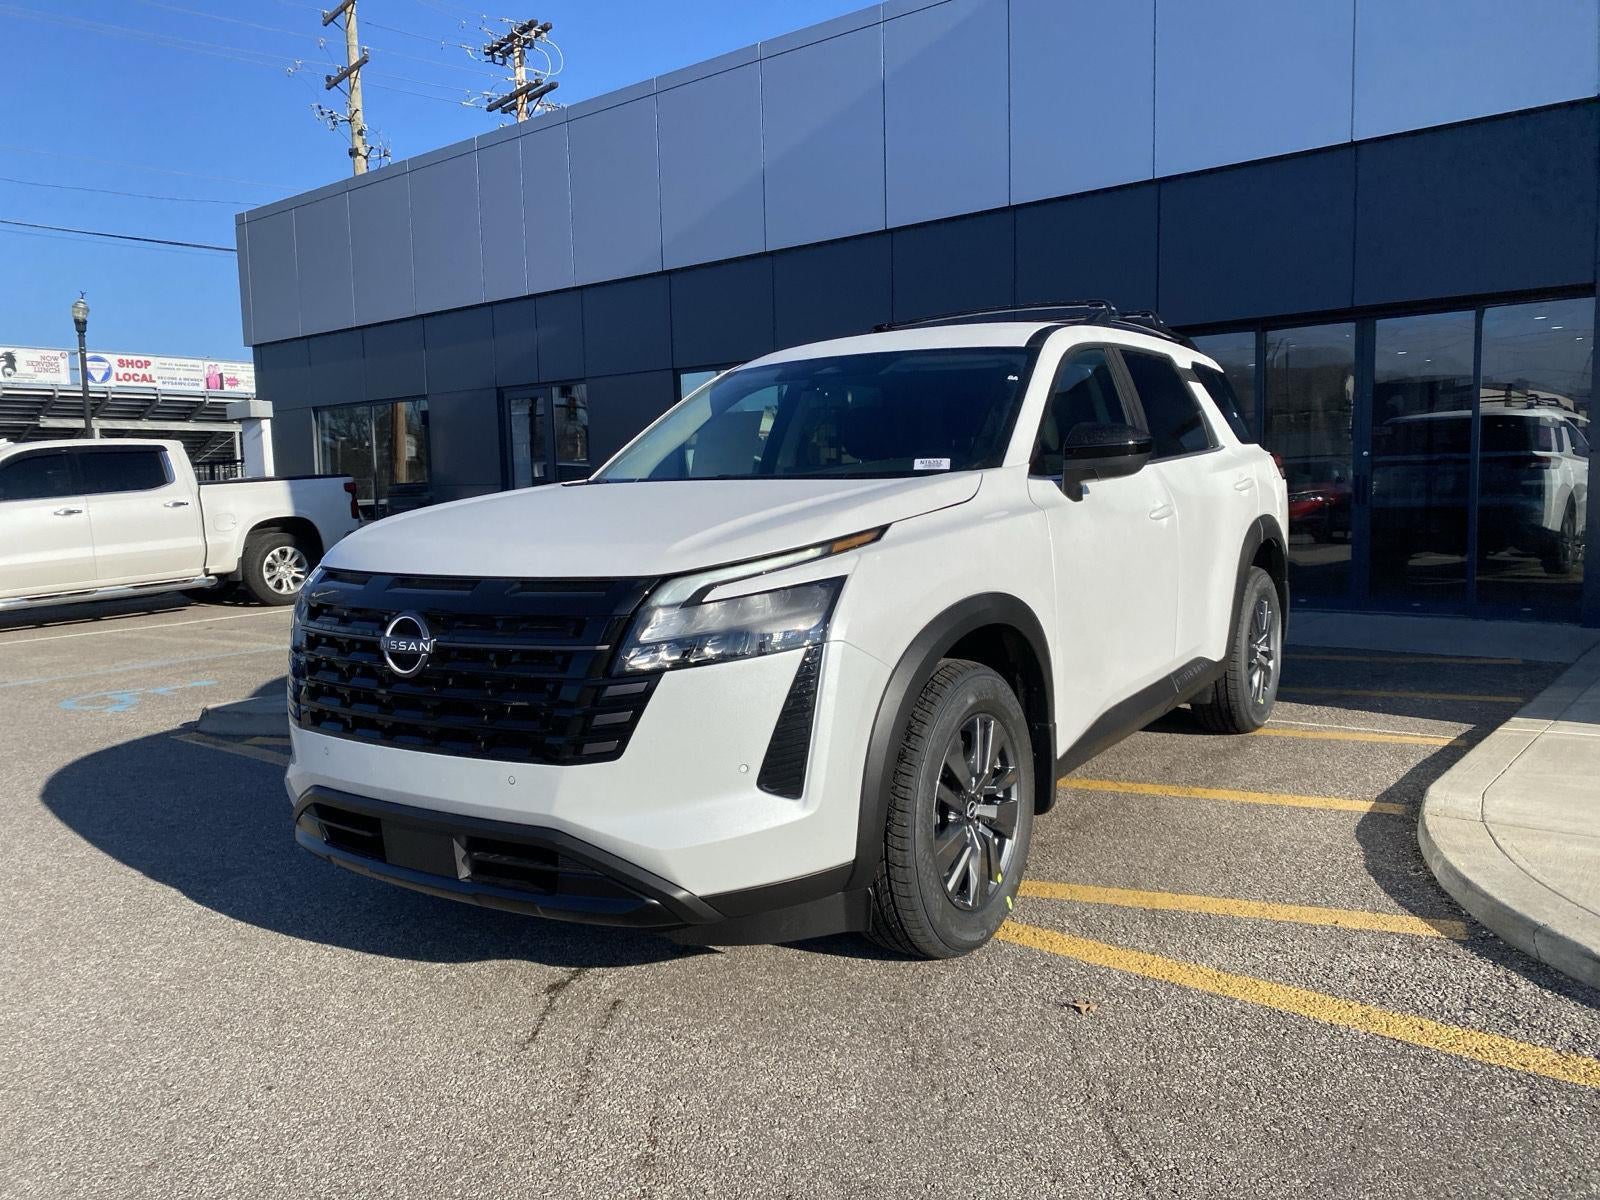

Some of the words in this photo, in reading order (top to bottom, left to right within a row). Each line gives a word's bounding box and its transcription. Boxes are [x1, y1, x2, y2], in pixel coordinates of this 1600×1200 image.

[26, 360, 60, 368] SERVING
[117, 358, 151, 369] SHOP
[115, 372, 156, 383] LOCAL
[380, 638, 430, 652] NISSAN
